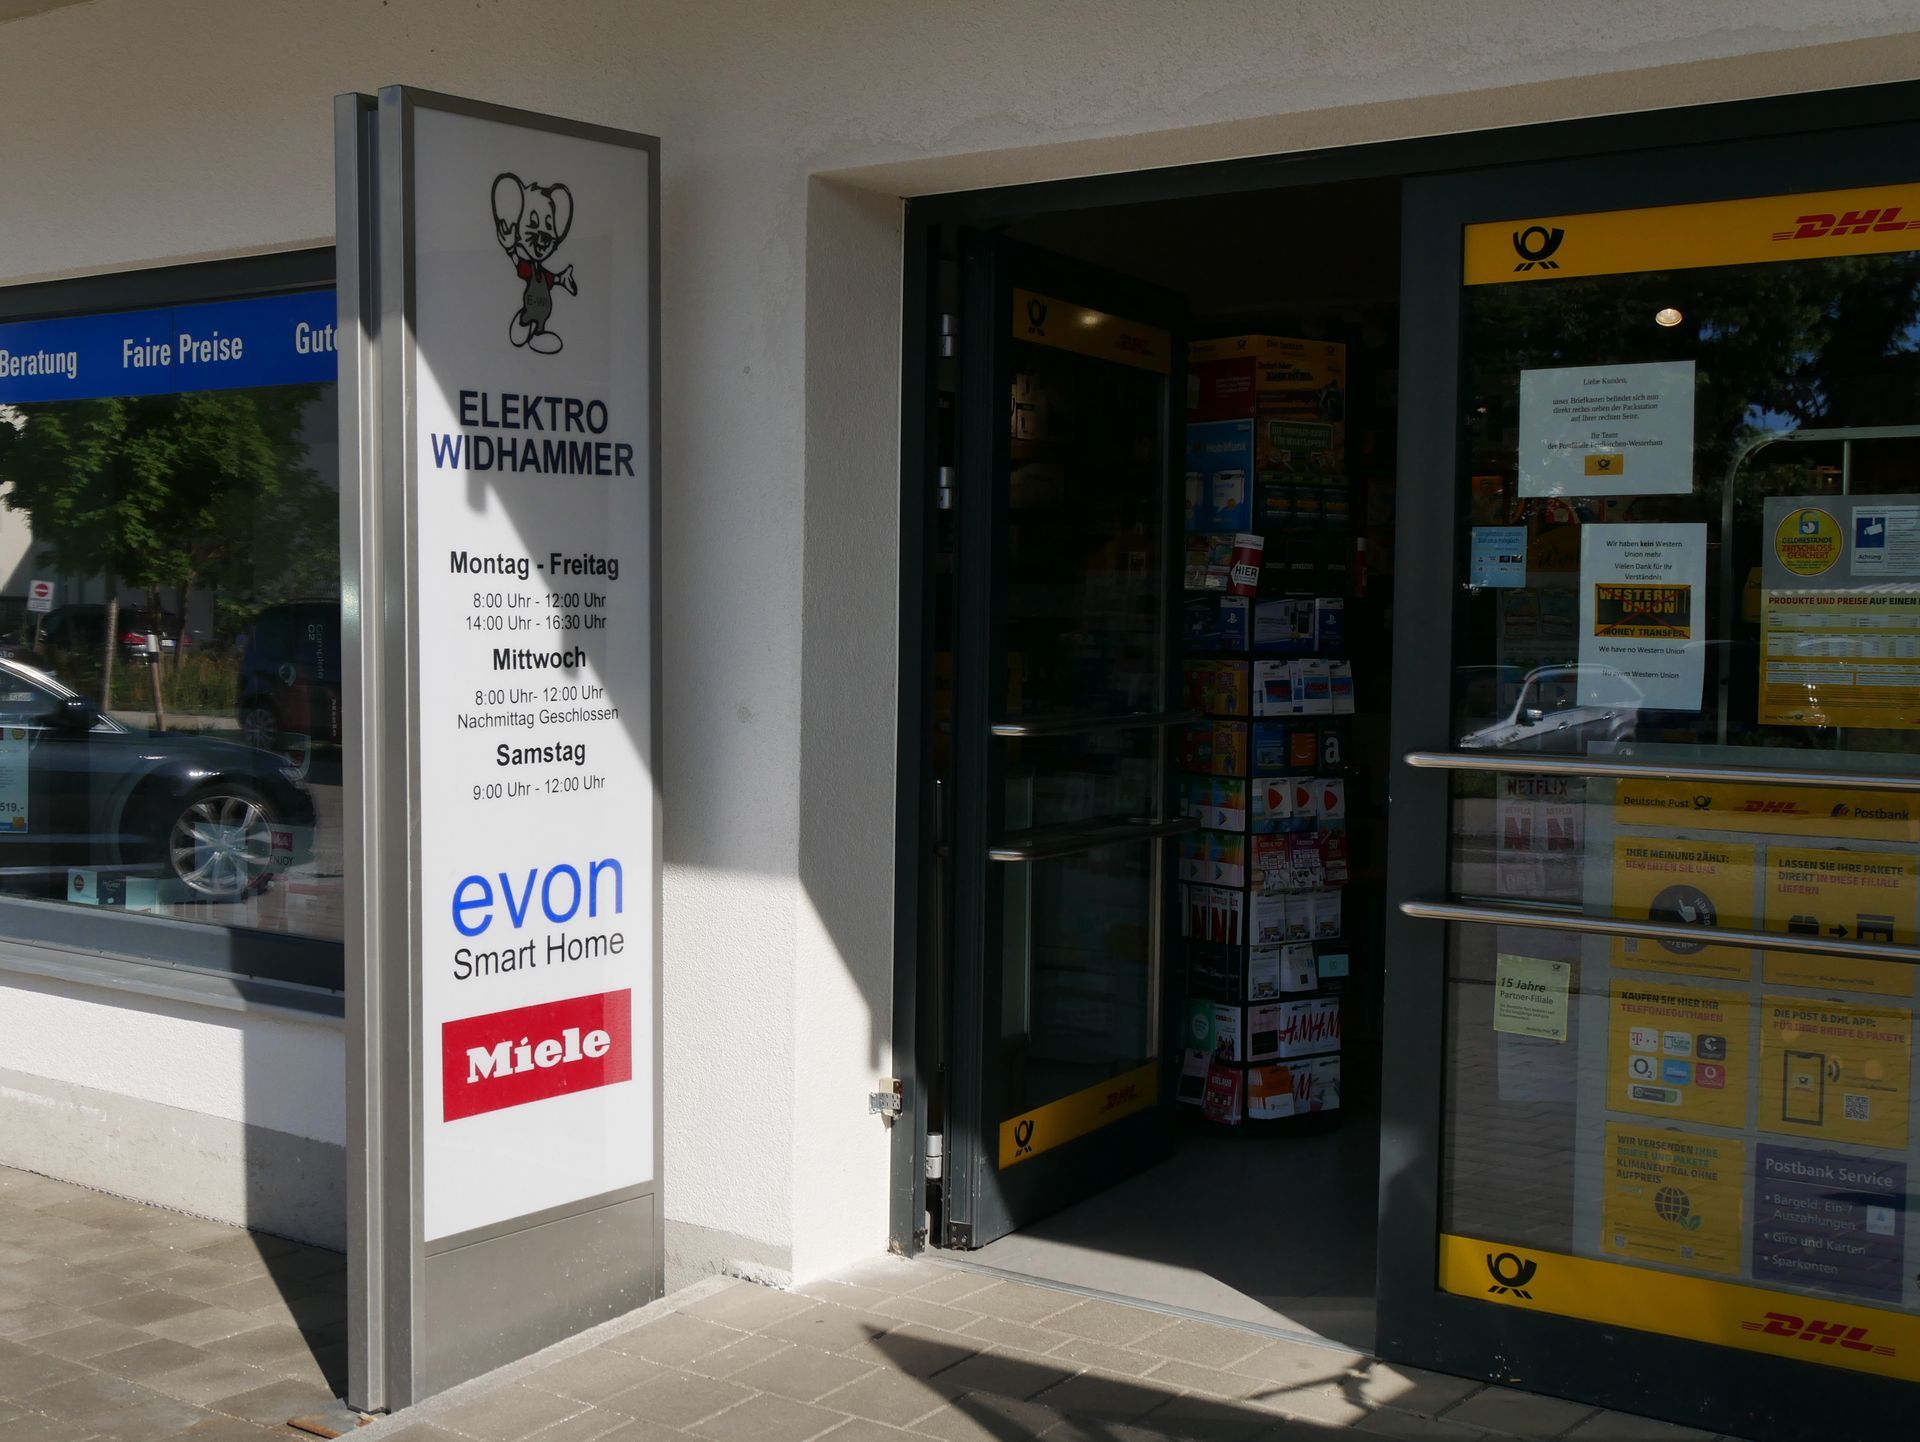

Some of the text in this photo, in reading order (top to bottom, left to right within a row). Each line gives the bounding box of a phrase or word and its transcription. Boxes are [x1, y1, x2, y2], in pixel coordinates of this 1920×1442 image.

[1793, 207, 1908, 239] DHL
[123, 331, 243, 368] Faire Preise
[0, 349, 77, 379] Beratung
[459, 390, 608, 434] ELEKTRO
[431, 432, 635, 476] WIDHAMMER
[450, 551, 620, 580] Montag Freitag
[1235, 565, 1258, 578] HIER
[473, 592, 606, 609] 8:00 Uhr 12:00 Uhr
[1600, 588, 1676, 601] WESTERN
[1769, 597, 1815, 605] PRODUKTE
[1816, 597, 1836, 605] UND
[1837, 597, 1868, 605] PREISE
[1869, 597, 1887, 605] AUF
[1889, 597, 1916, 605] EINEN
[1622, 601, 1676, 613] UNION
[466, 614, 607, 631] 14:00 Uhr 16:30 Uhr
[1604, 628, 1634, 636] MONEY
[493, 646, 586, 671] Mittwoch
[475, 689, 505, 705] 8:00
[543, 686, 578, 703] 12:00
[581, 685, 604, 700] Uhr
[457, 706, 619, 730] Nachmittag Geschlossen
[496, 741, 586, 767] Samstag
[473, 775, 605, 801] 9:00 Uhr 12:00 Uhr
[1507, 779, 1568, 795] NETFLIX
[1623, 795, 1689, 808] Deutsche Post
[1744, 800, 1796, 813] DHL
[1854, 807, 1910, 821] Postbank
[1626, 847, 1730, 863] IHRE MEINUNG ZÄHLT:
[1625, 860, 1677, 872] BEWERTEN
[1679, 862, 1694, 873] SIE
[1778, 859, 1904, 876] LASSEN SIE IHRE PAKETE
[1778, 871, 1900, 888] DIREKT IN DIESE FILIALE
[452, 858, 623, 937] evon
[1778, 884, 1819, 895] LIEFERN
[454, 932, 624, 980] Smart Home
[1501, 977, 1546, 993] 15 Jahre
[1500, 990, 1554, 1005] Partner-Filiale
[1621, 991, 1719, 1010] KAUFEN SIE HIER IHR
[1774, 1008, 1790, 1019] DIE
[1792, 1011, 1818, 1021] POST
[1820, 1014, 1828, 1022] &
[1830, 1015, 1850, 1025] DHL
[1866, 1031, 1905, 1043] PAKETE
[467, 1027, 611, 1084] Miele
[1617, 1136, 1636, 1145] WIR
[1637, 1138, 1694, 1154] VERSENDEN
[1616, 1158, 1718, 1181] KLIMANEUTRAL OHNE
[1616, 1169, 1662, 1184] AUFPREIS
[1766, 1158, 1894, 1187] Postbank Service
[1774, 1210, 1856, 1231] Auszahlungen
[1772, 1232, 1866, 1256] Giro und Karten
[1772, 1254, 1839, 1274] Sparkonten
[1762, 1312, 1874, 1351] DHL
